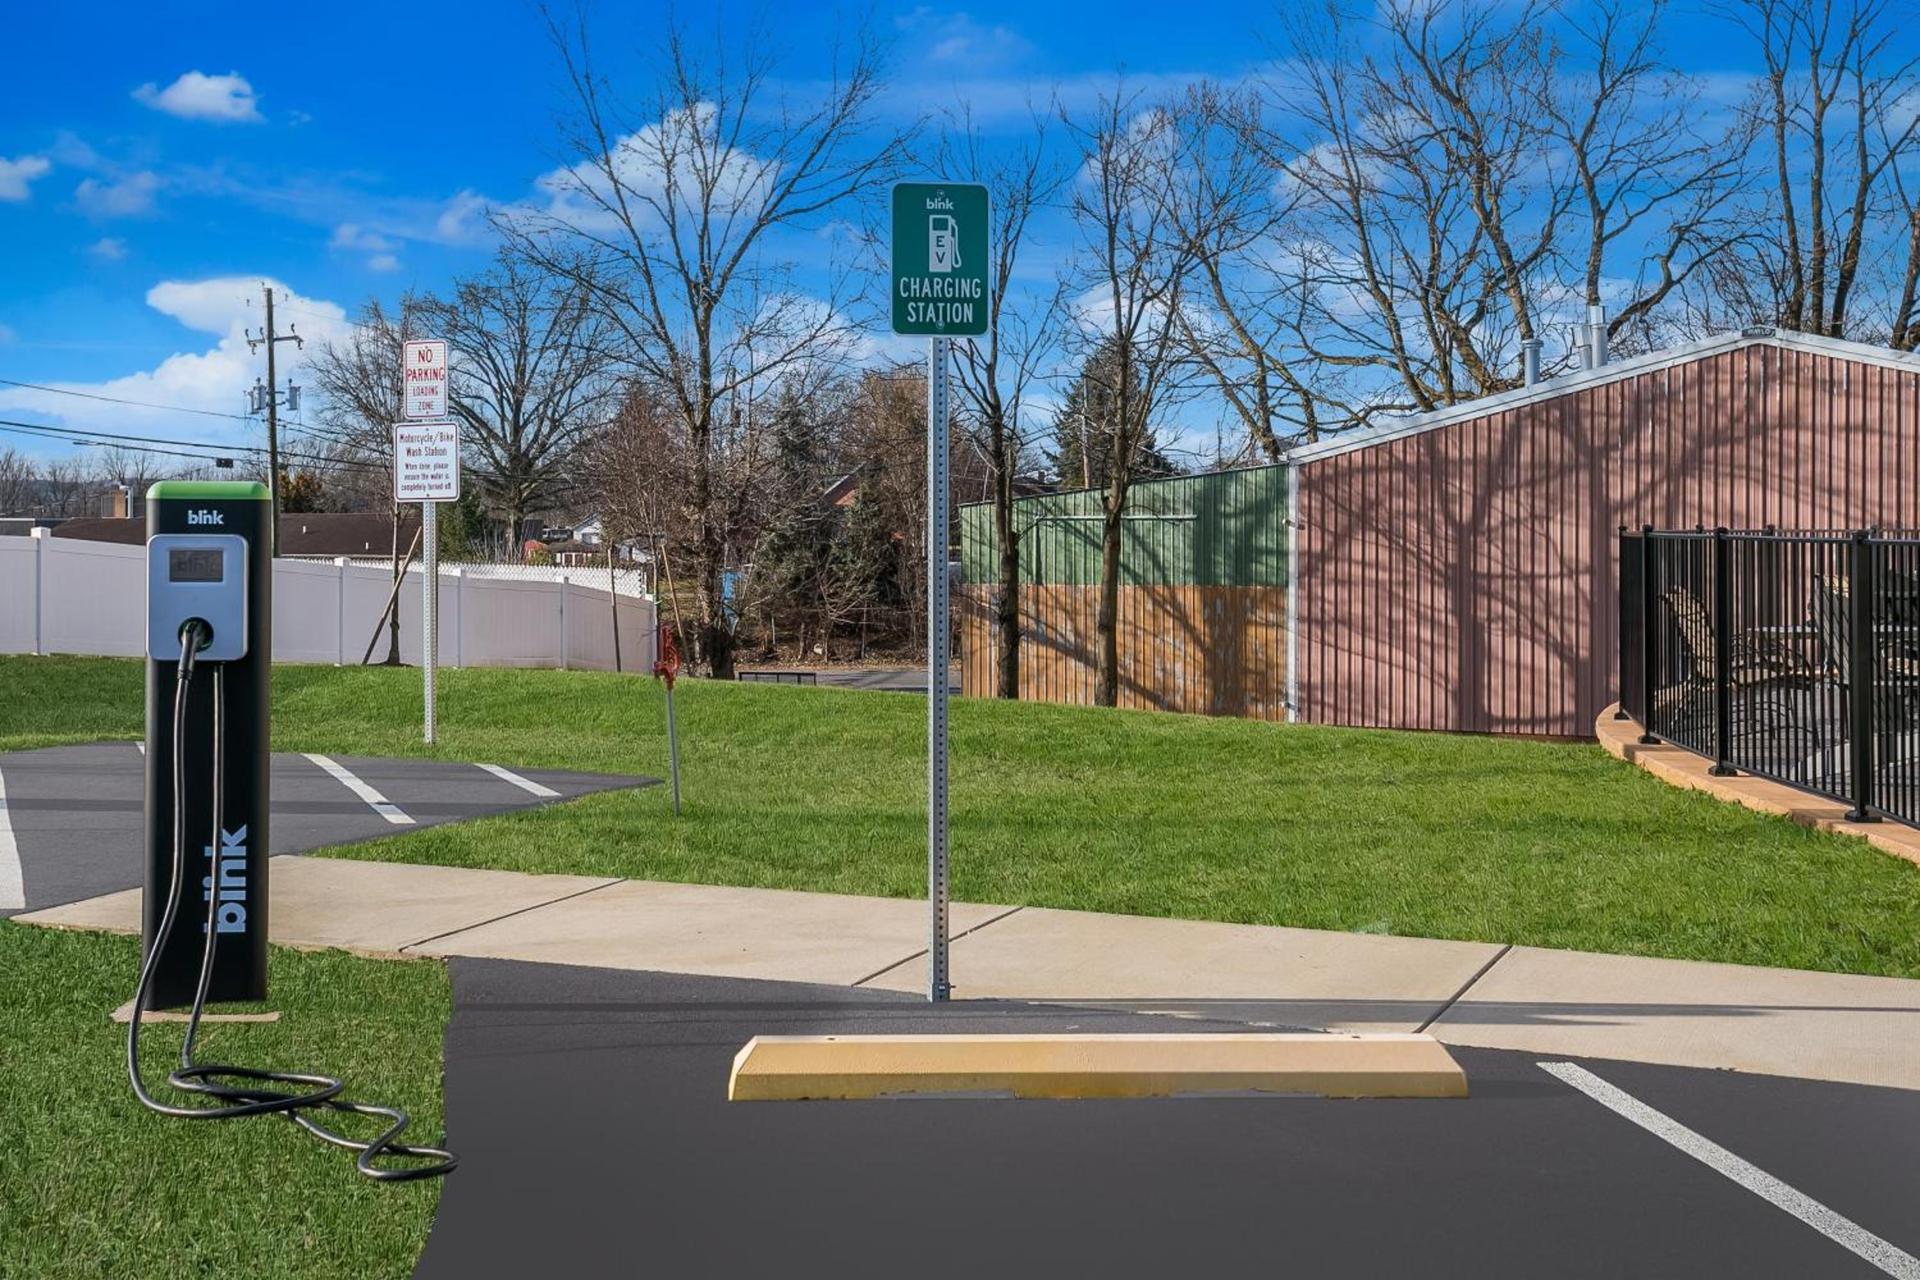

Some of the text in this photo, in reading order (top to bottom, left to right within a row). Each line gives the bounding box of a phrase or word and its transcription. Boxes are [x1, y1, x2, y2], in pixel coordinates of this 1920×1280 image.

[926, 197, 954, 210] blink
[900, 277, 981, 299] CHARGING
[907, 302, 974, 323] STATION
[418, 349, 433, 363] NO
[407, 367, 444, 382] PARKING
[413, 386, 438, 396] LOADING
[406, 446, 448, 457] Wash Station
[187, 510, 224, 525] blink
[202, 824, 247, 933] blink
